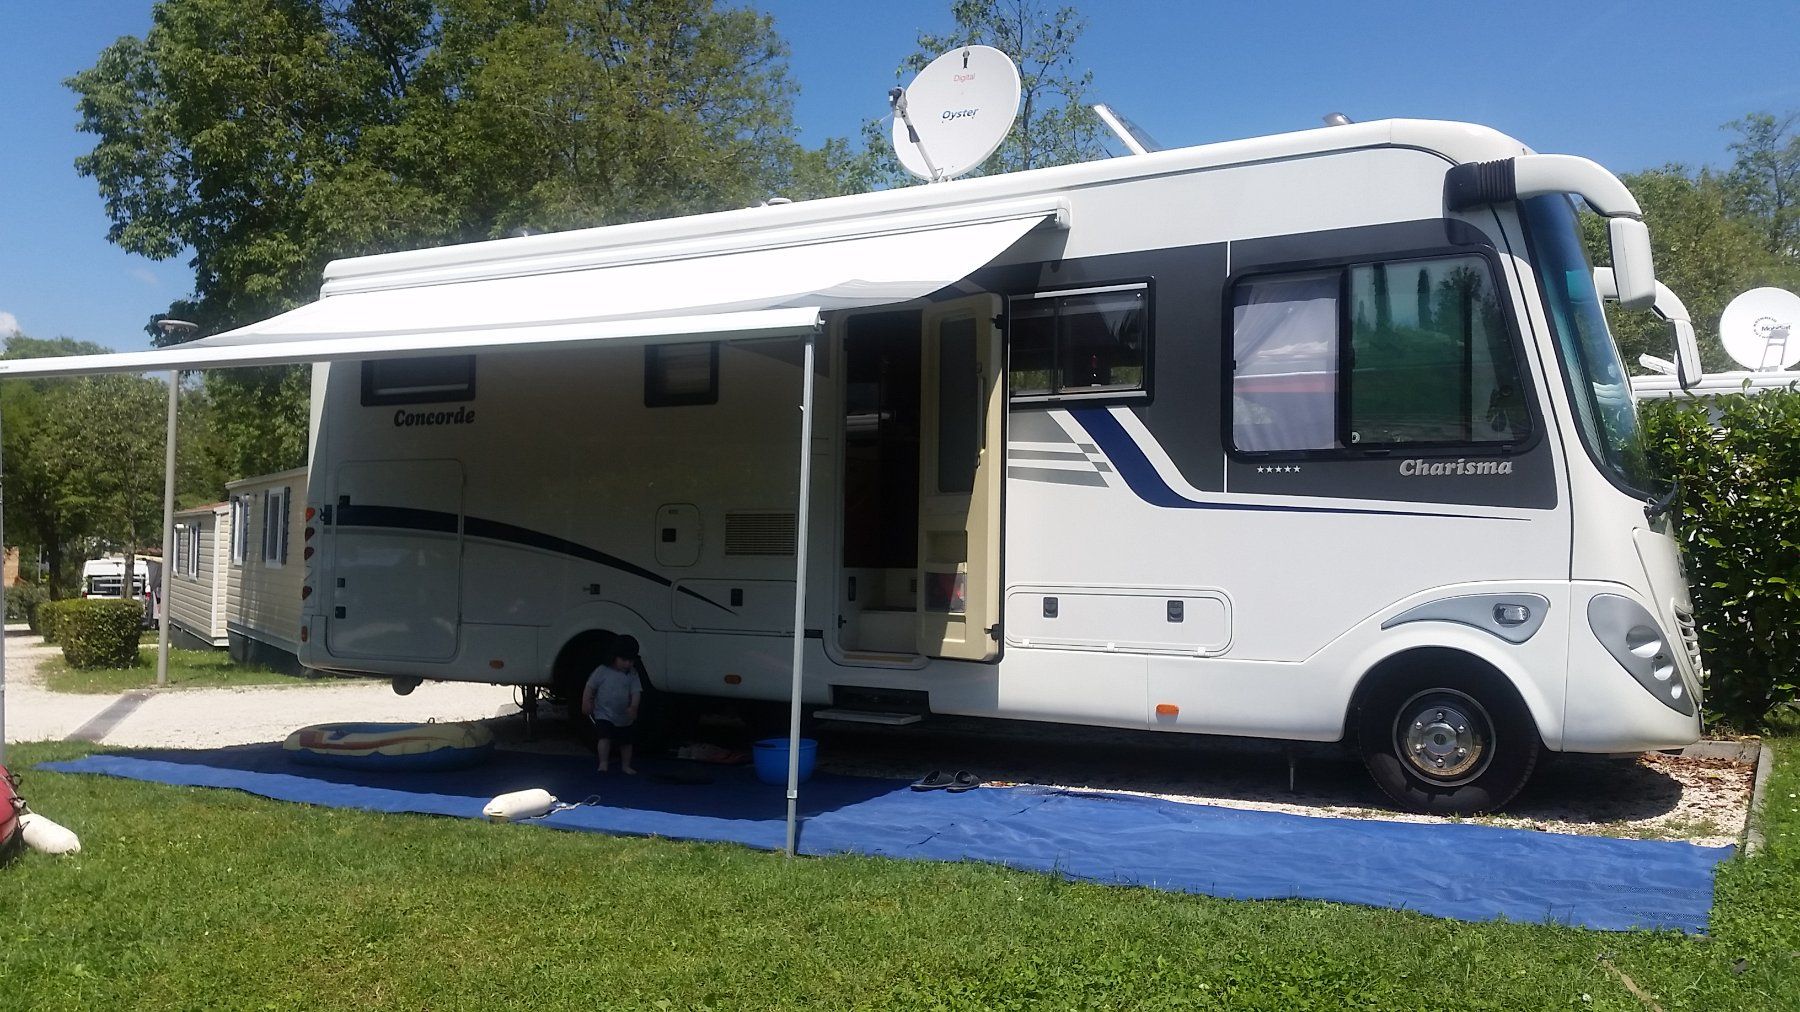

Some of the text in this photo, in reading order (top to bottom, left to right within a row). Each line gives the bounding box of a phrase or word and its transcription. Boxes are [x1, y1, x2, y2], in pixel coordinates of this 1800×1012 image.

[953, 73, 976, 82] Digital
[942, 108, 979, 120] Oyster
[393, 406, 476, 427] Concorde
[1400, 458, 1513, 476] Charisma
